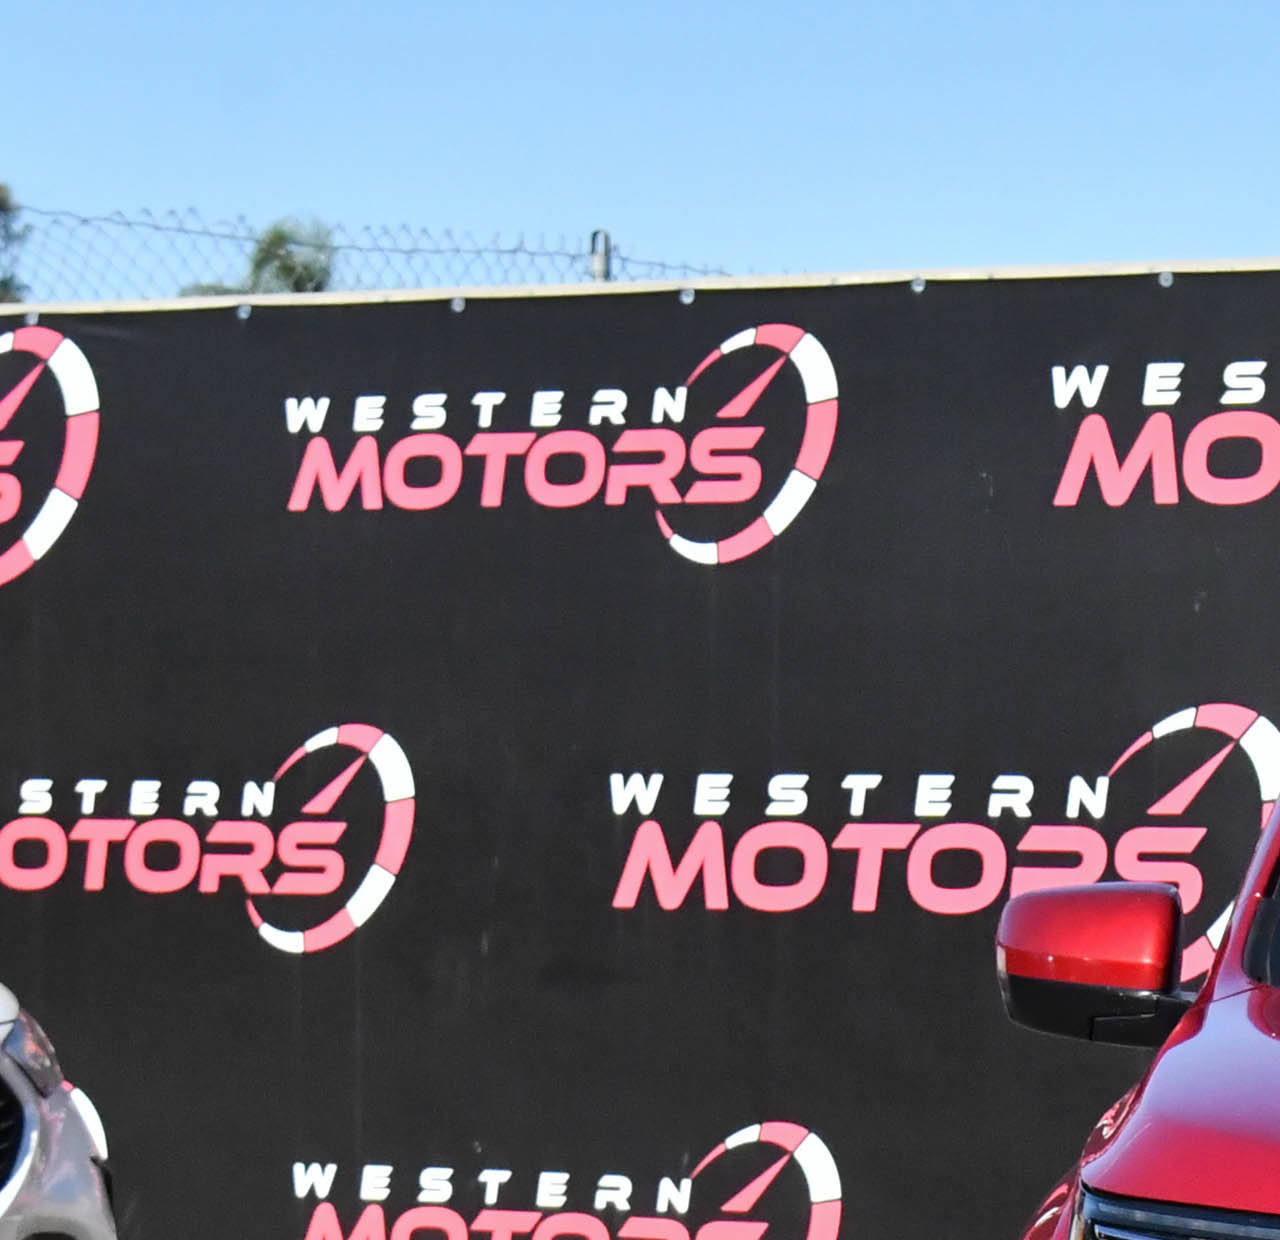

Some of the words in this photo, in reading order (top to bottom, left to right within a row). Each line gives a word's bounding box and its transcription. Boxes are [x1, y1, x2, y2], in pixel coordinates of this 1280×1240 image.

[285, 386, 685, 433] WESTERN
[287, 427, 765, 512] MOTORS
[610, 773, 1110, 819] WESTERN
[612, 820, 1208, 915] MOTORS
[293, 1162, 692, 1213] WESTERN
